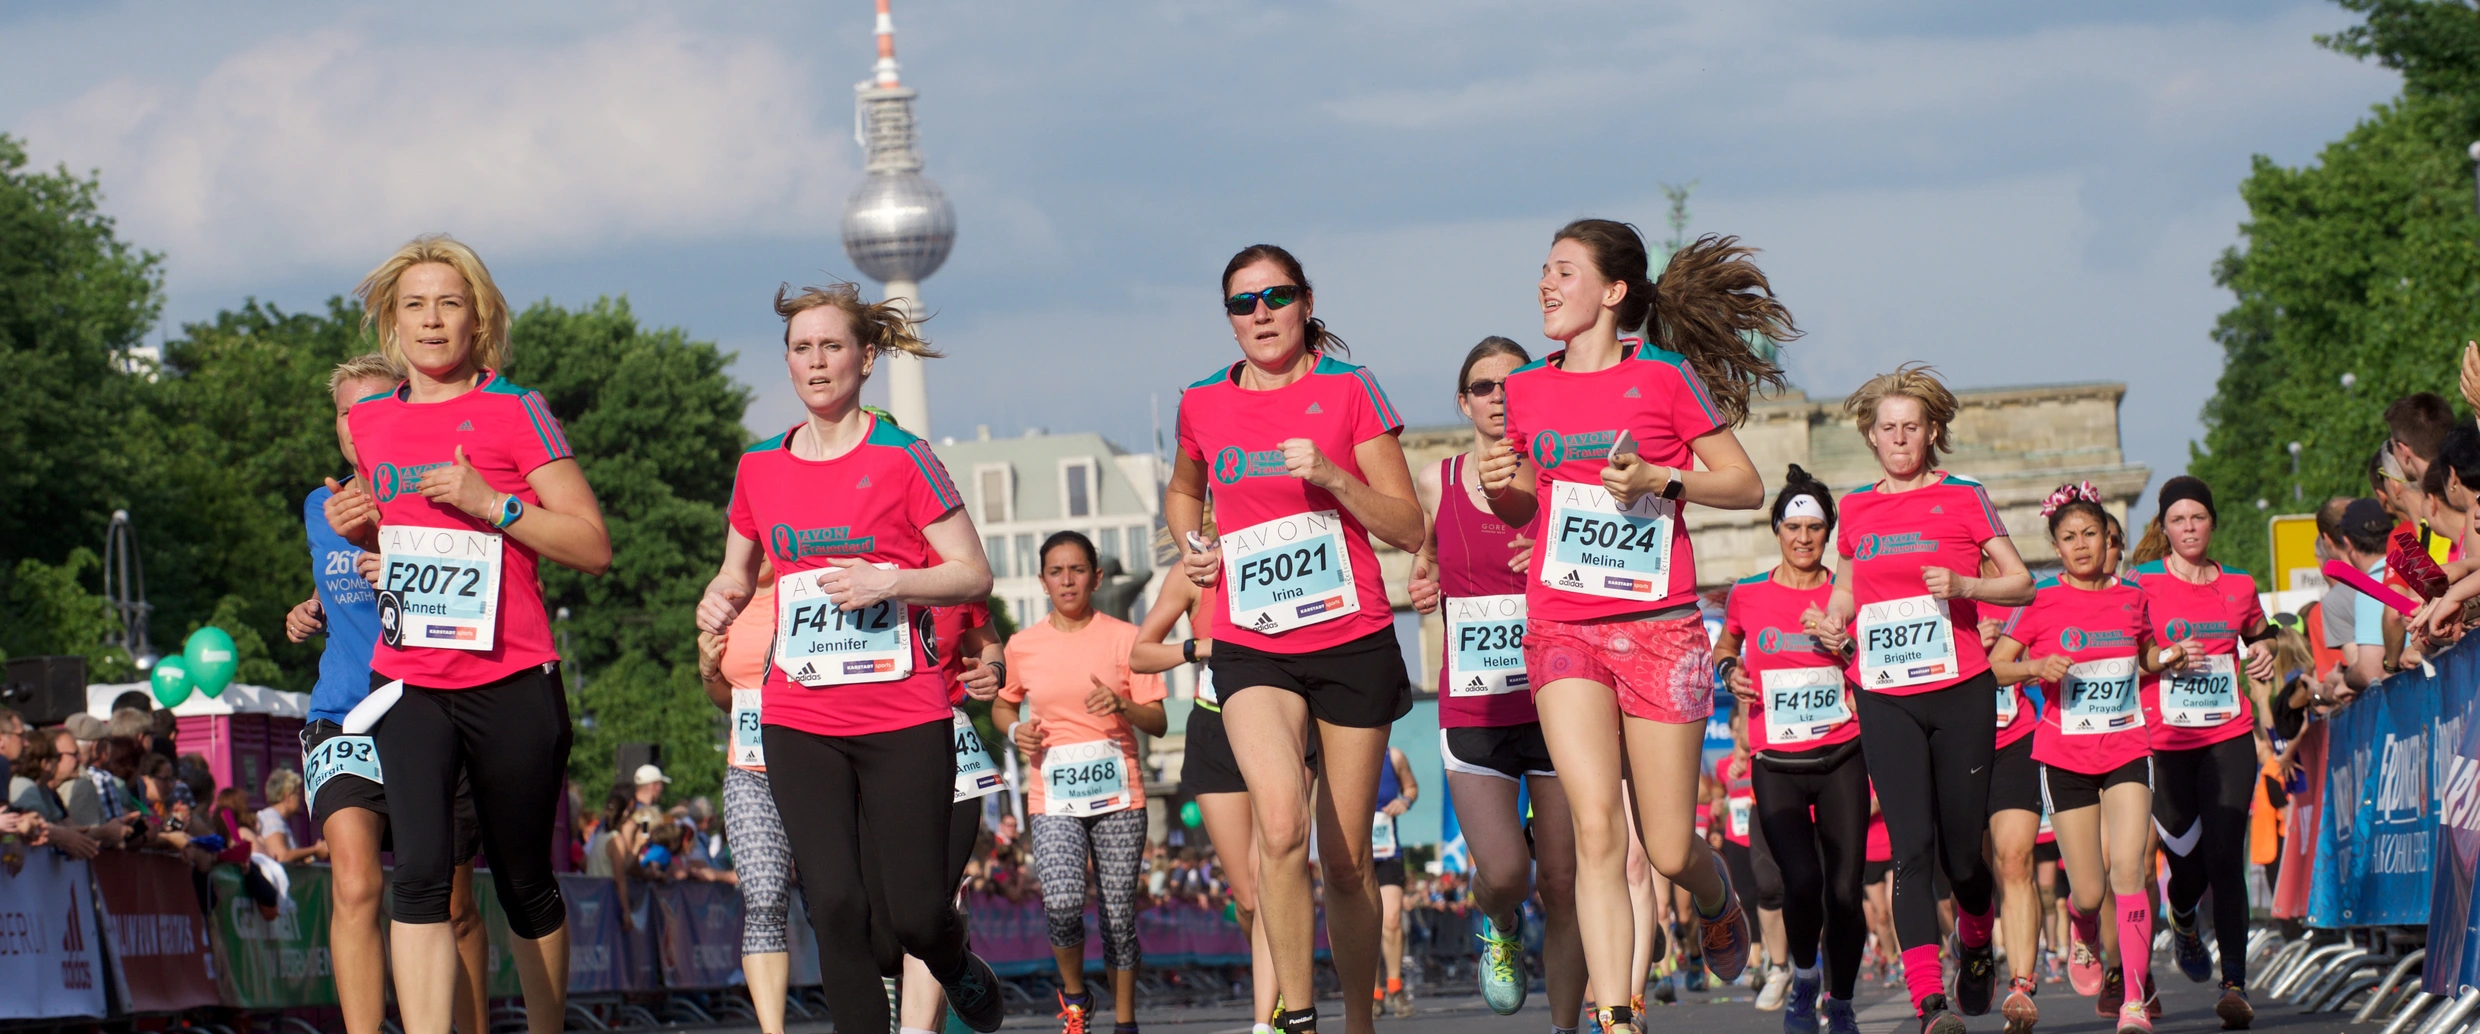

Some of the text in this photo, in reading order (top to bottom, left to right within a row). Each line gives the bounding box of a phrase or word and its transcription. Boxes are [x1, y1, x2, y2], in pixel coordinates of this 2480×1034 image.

[1569, 431, 1612, 446] AVON
[1252, 450, 1284, 461] AVO
[801, 527, 845, 541] AVON
[1236, 514, 1328, 555] AVON
[1481, 523, 1506, 531] GORE
[1560, 515, 1656, 553] F5024
[390, 530, 488, 556] AVON
[801, 539, 871, 554] Frauenlauf
[325, 550, 360, 575] 261
[1240, 542, 1327, 592] F5021
[1581, 552, 1625, 568] Melina
[387, 561, 480, 597] F2072
[1559, 579, 1584, 589] adidas
[1272, 587, 1304, 602] Irina
[403, 600, 447, 615] Annett
[1300, 604, 1325, 614] KARSTADT
[1458, 598, 1517, 618] AVO
[1866, 599, 1938, 623] AVON
[791, 599, 890, 637] F4112
[429, 628, 456, 636] KARSTADT
[1253, 621, 1279, 632] adidas
[1460, 624, 1524, 652] F238
[1869, 621, 1937, 651] F3877
[808, 637, 868, 654] Jennifer
[1483, 656, 1518, 667] Helen
[1884, 651, 1922, 664] Brigitte
[847, 662, 892, 671] KARSTADT sports
[2072, 659, 2135, 676] AVON
[795, 672, 822, 682] adidas
[1771, 667, 1839, 686] AVON
[1465, 685, 1488, 693] adidas
[2071, 678, 2133, 701] F2977
[2170, 675, 2229, 695] F4002
[1774, 689, 1837, 711] F4156
[2183, 699, 2219, 707] Carolina
[2089, 704, 2122, 714] Prayad
[740, 712, 759, 731] F3
[1800, 714, 1815, 722] Liz
[1051, 742, 1115, 763] AVON
[315, 763, 345, 787] Birgit
[1053, 761, 1116, 787] F3468
[1069, 786, 1103, 798] Massiel
